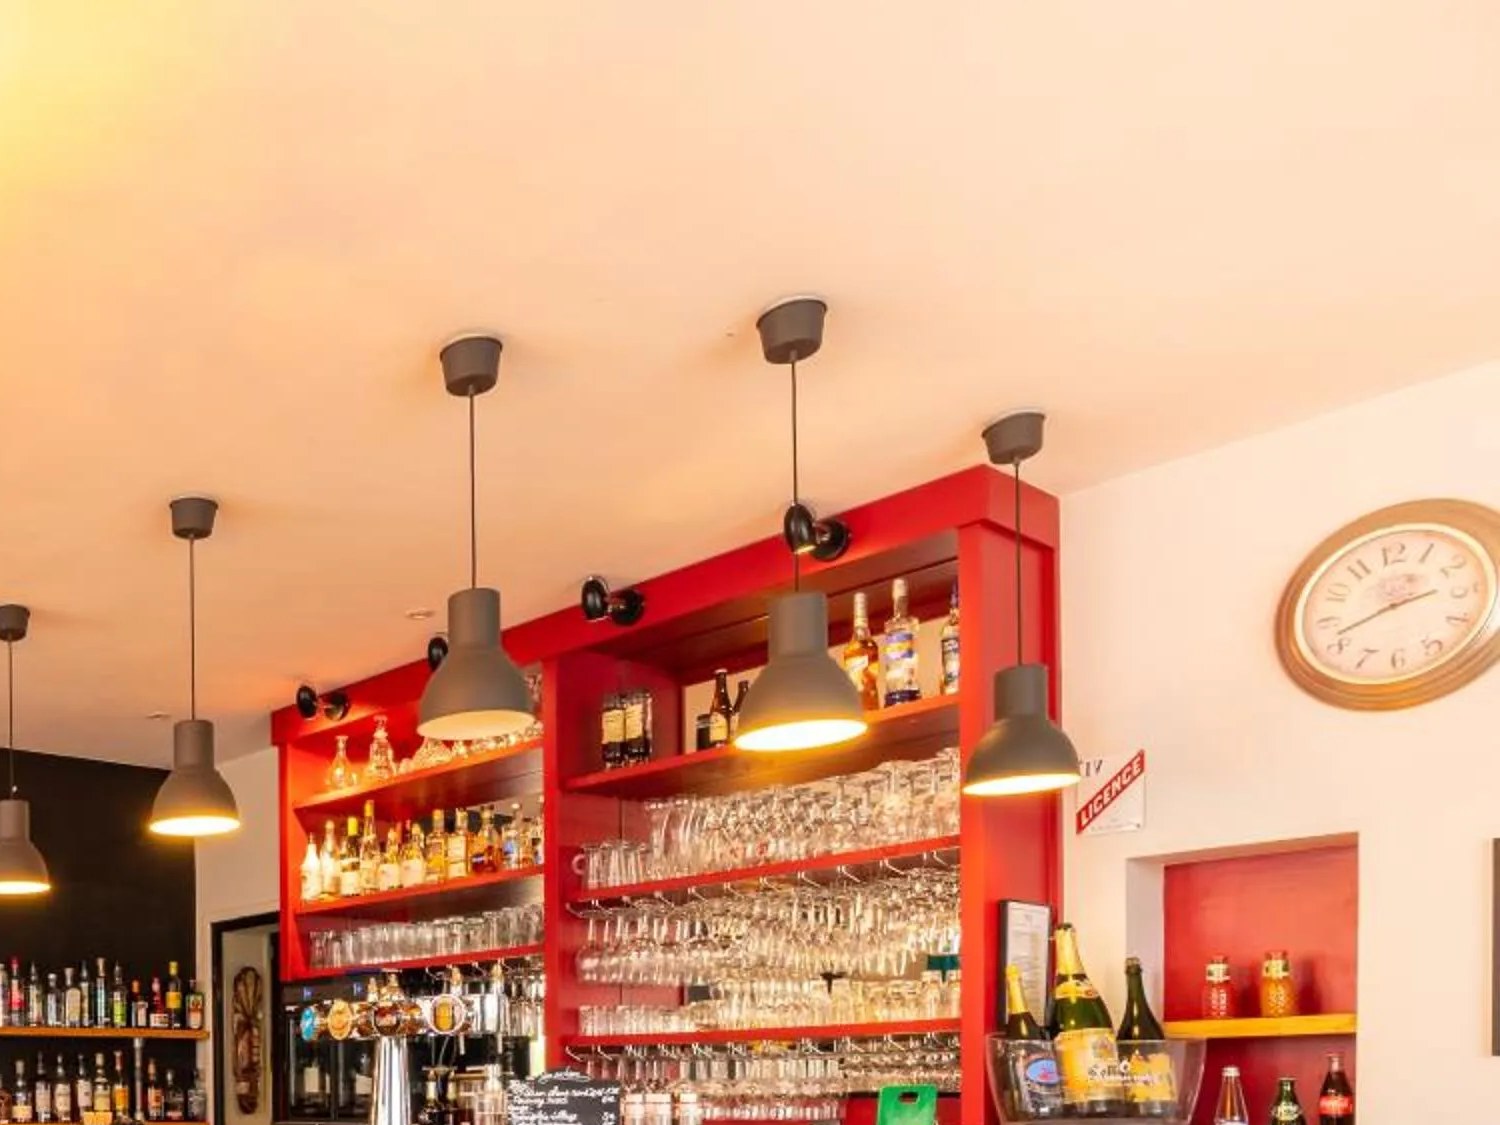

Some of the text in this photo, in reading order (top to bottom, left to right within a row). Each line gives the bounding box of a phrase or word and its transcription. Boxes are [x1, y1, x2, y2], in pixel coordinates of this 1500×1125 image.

[1381, 543, 1406, 567] 12
[1418, 543, 1435, 564] 1
[1346, 559, 1372, 580] 11
[1440, 554, 1467, 579] 2
[1325, 582, 1351, 602] 10
[1315, 616, 1343, 630] 9
[1326, 636, 1352, 656] 8
[1421, 634, 1444, 656] 5
[1355, 648, 1380, 669] 7
[1390, 648, 1407, 669] 6
[1080, 756, 1142, 828] LICENCE
